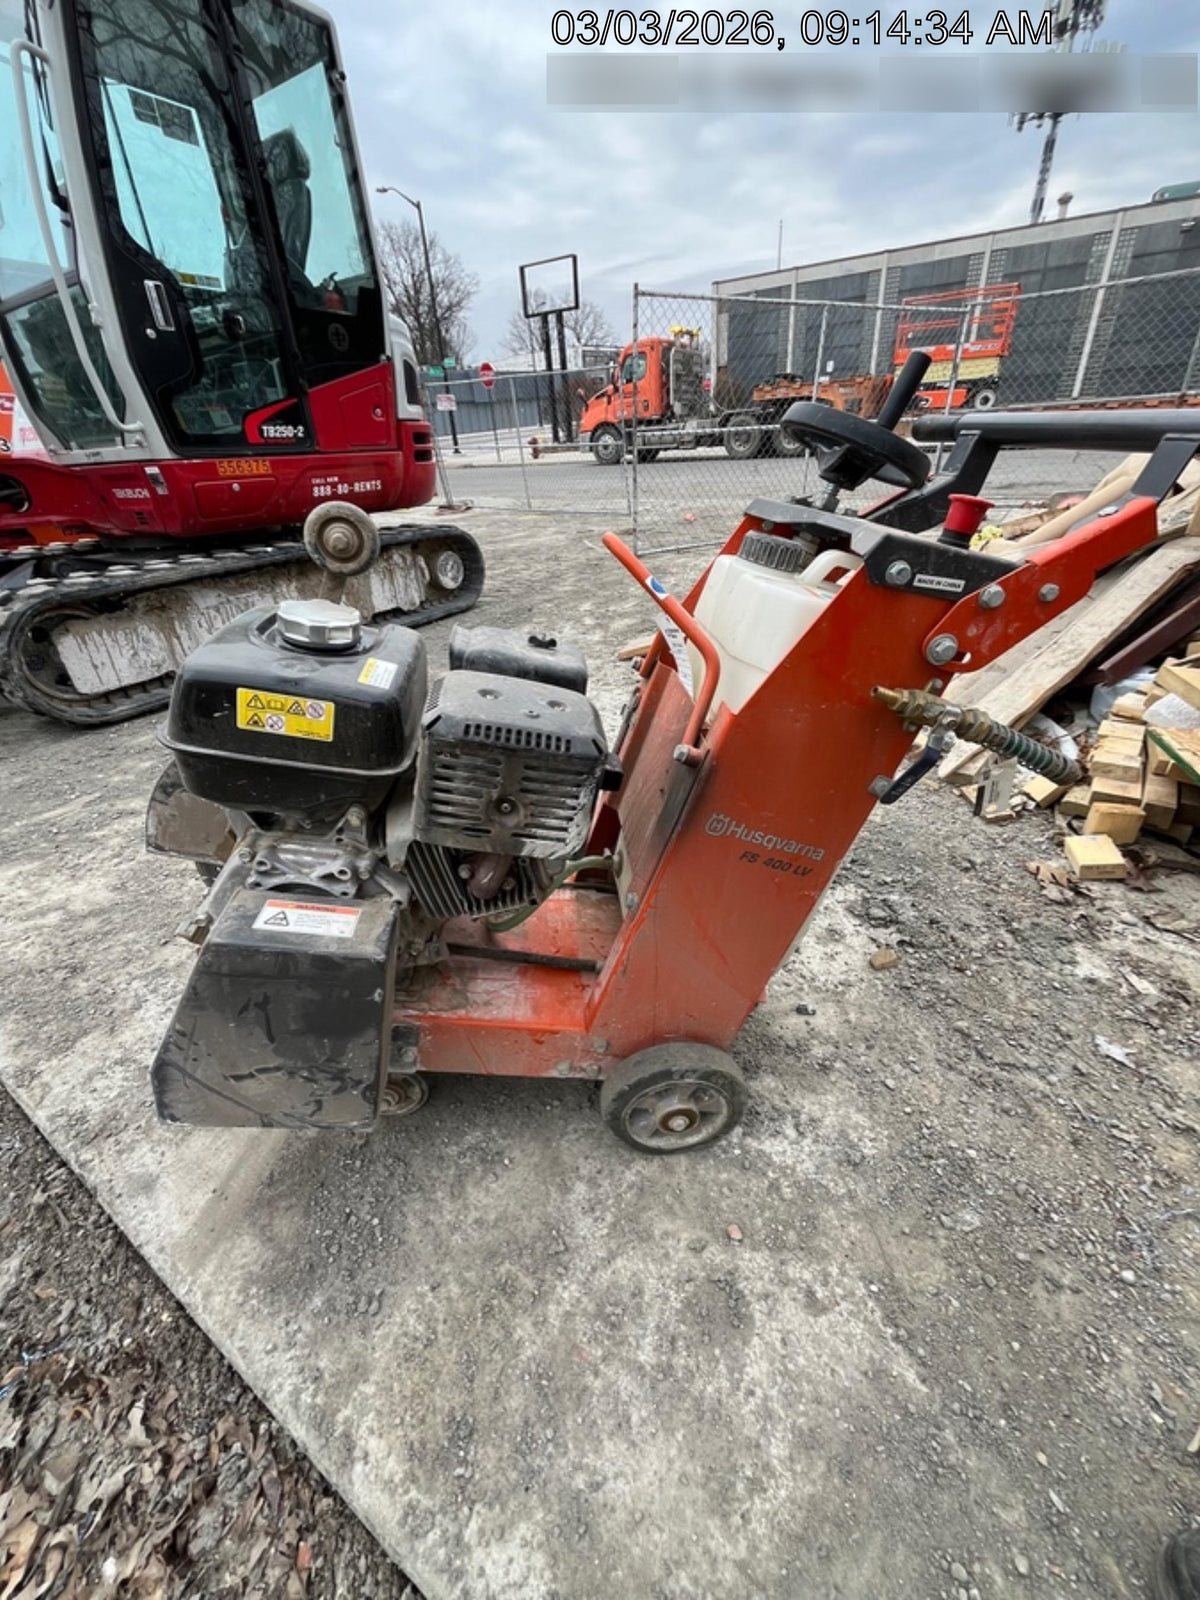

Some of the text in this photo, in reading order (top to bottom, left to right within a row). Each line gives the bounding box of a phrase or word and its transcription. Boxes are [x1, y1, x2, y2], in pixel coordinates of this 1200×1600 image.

[261, 425, 305, 438] TB250-2
[312, 480, 382, 497] 888-80-RENTS
[917, 578, 935, 586] MADE
[942, 581, 961, 589] CHINA
[726, 821, 825, 861] Husqvarna
[740, 851, 813, 877] FS 400 LV
